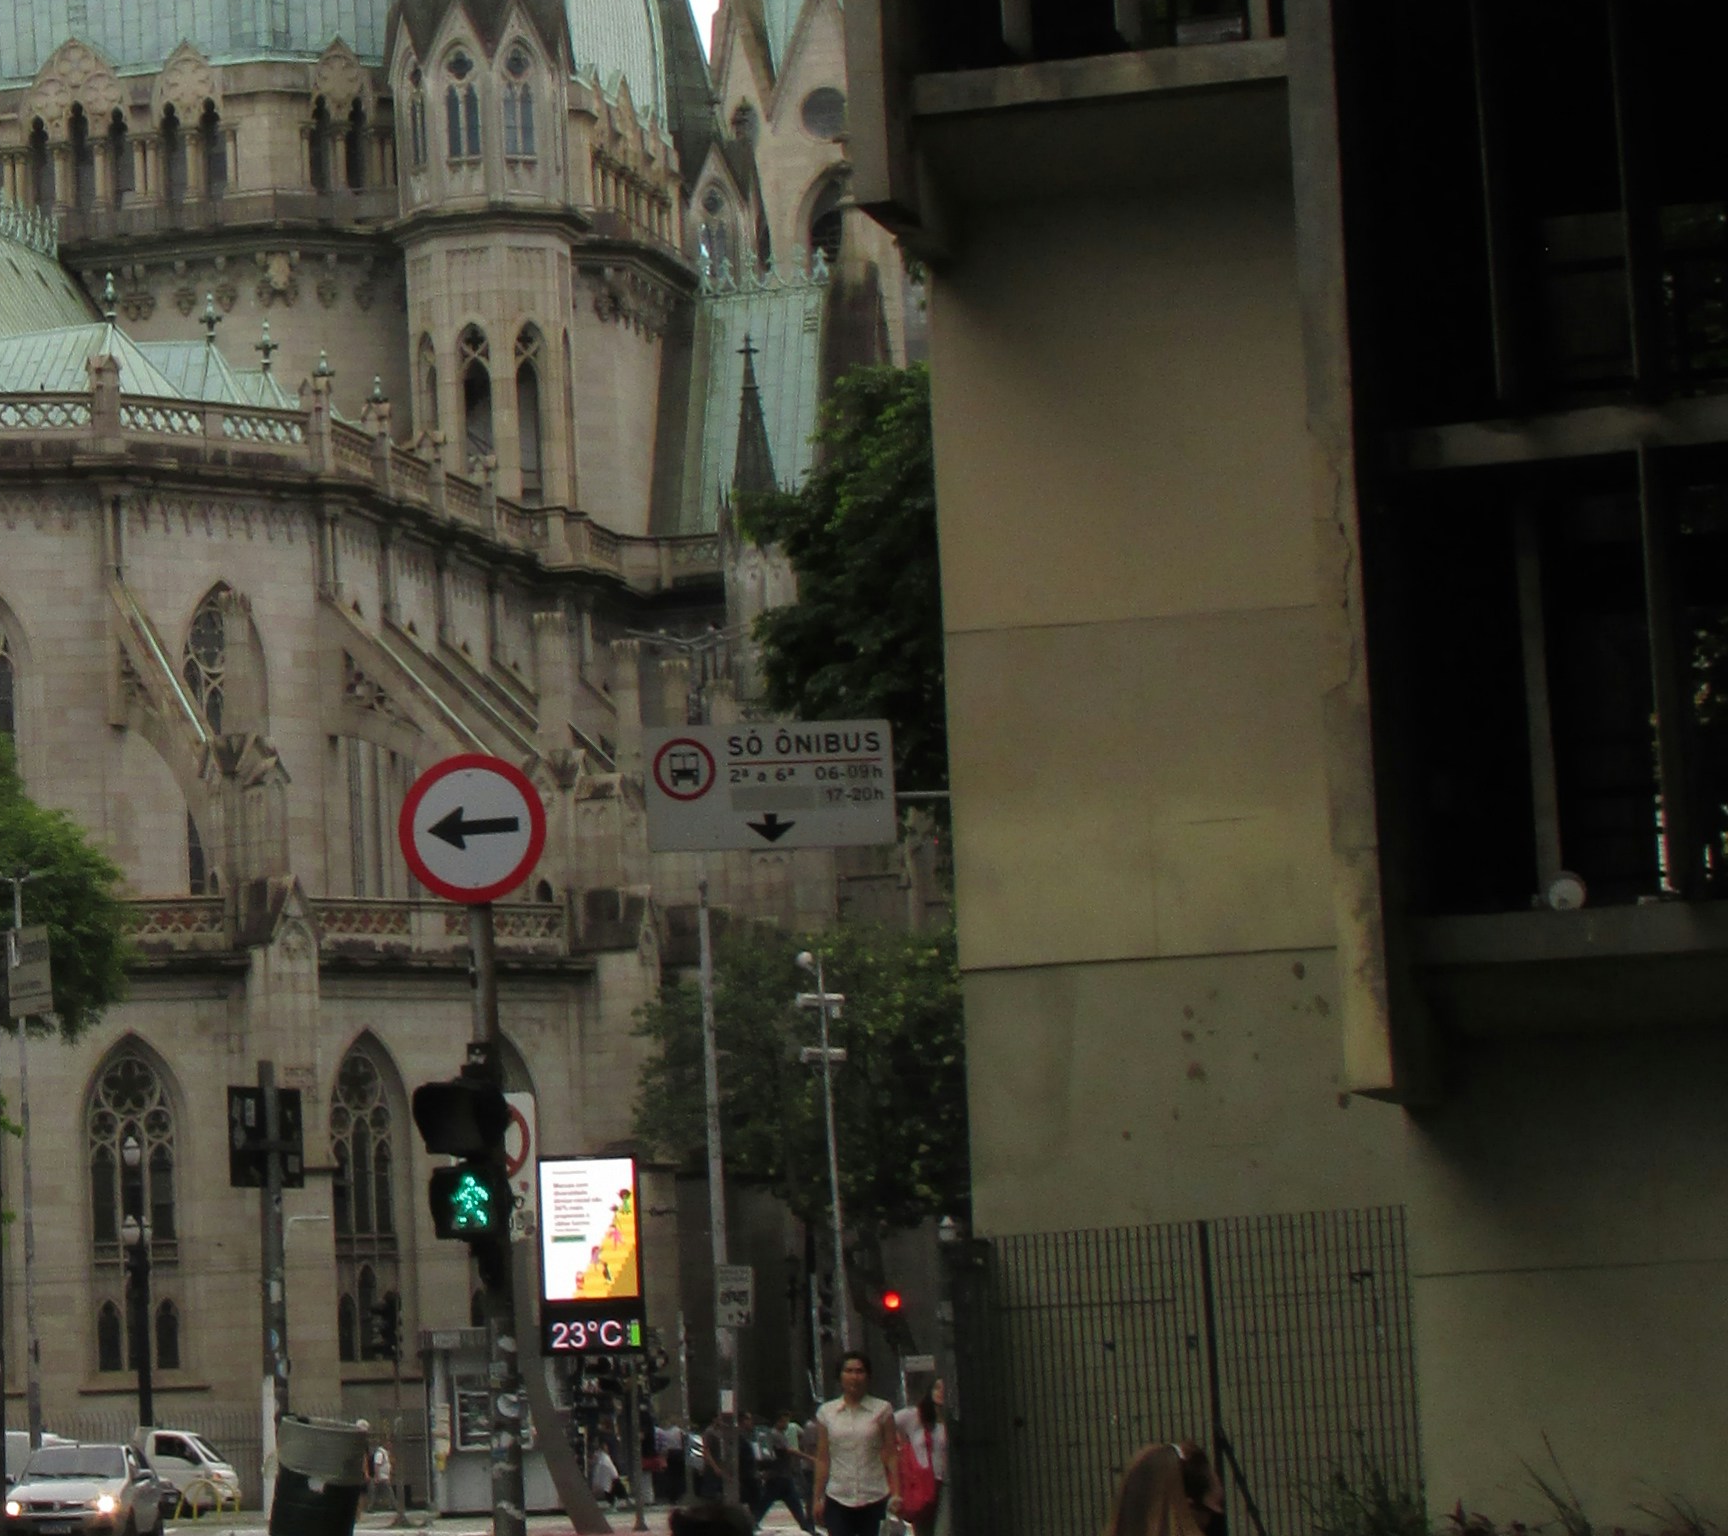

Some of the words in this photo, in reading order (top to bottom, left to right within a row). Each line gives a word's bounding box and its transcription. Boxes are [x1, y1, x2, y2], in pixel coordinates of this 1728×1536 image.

[727, 729, 763, 757] SÓ
[775, 728, 881, 755] ÔNIBUS
[756, 771, 766, 782] a
[552, 1320, 623, 1349] 23°C
